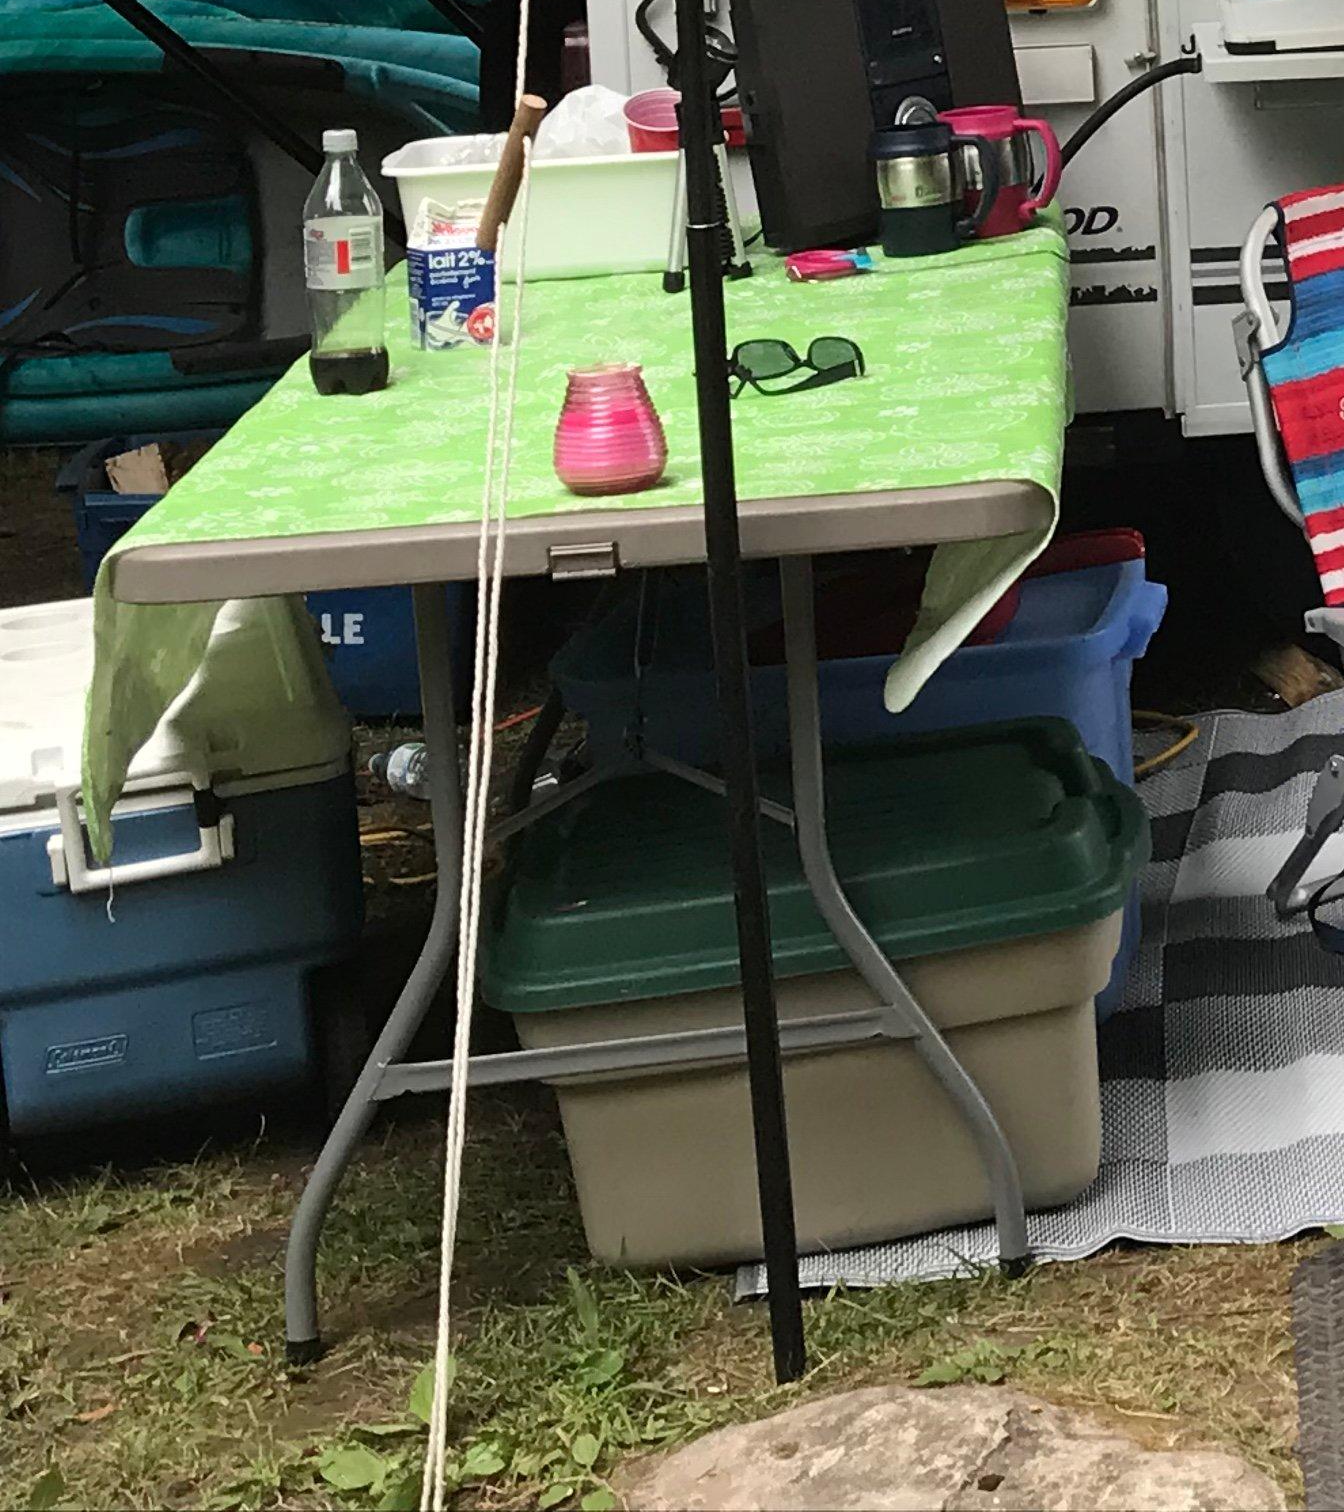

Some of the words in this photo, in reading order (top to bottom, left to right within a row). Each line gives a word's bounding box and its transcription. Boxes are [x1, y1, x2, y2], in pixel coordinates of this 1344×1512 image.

[1063, 205, 1119, 236] OD
[428, 252, 456, 270] lait
[457, 249, 486, 268] 2%
[321, 613, 365, 645] LE
